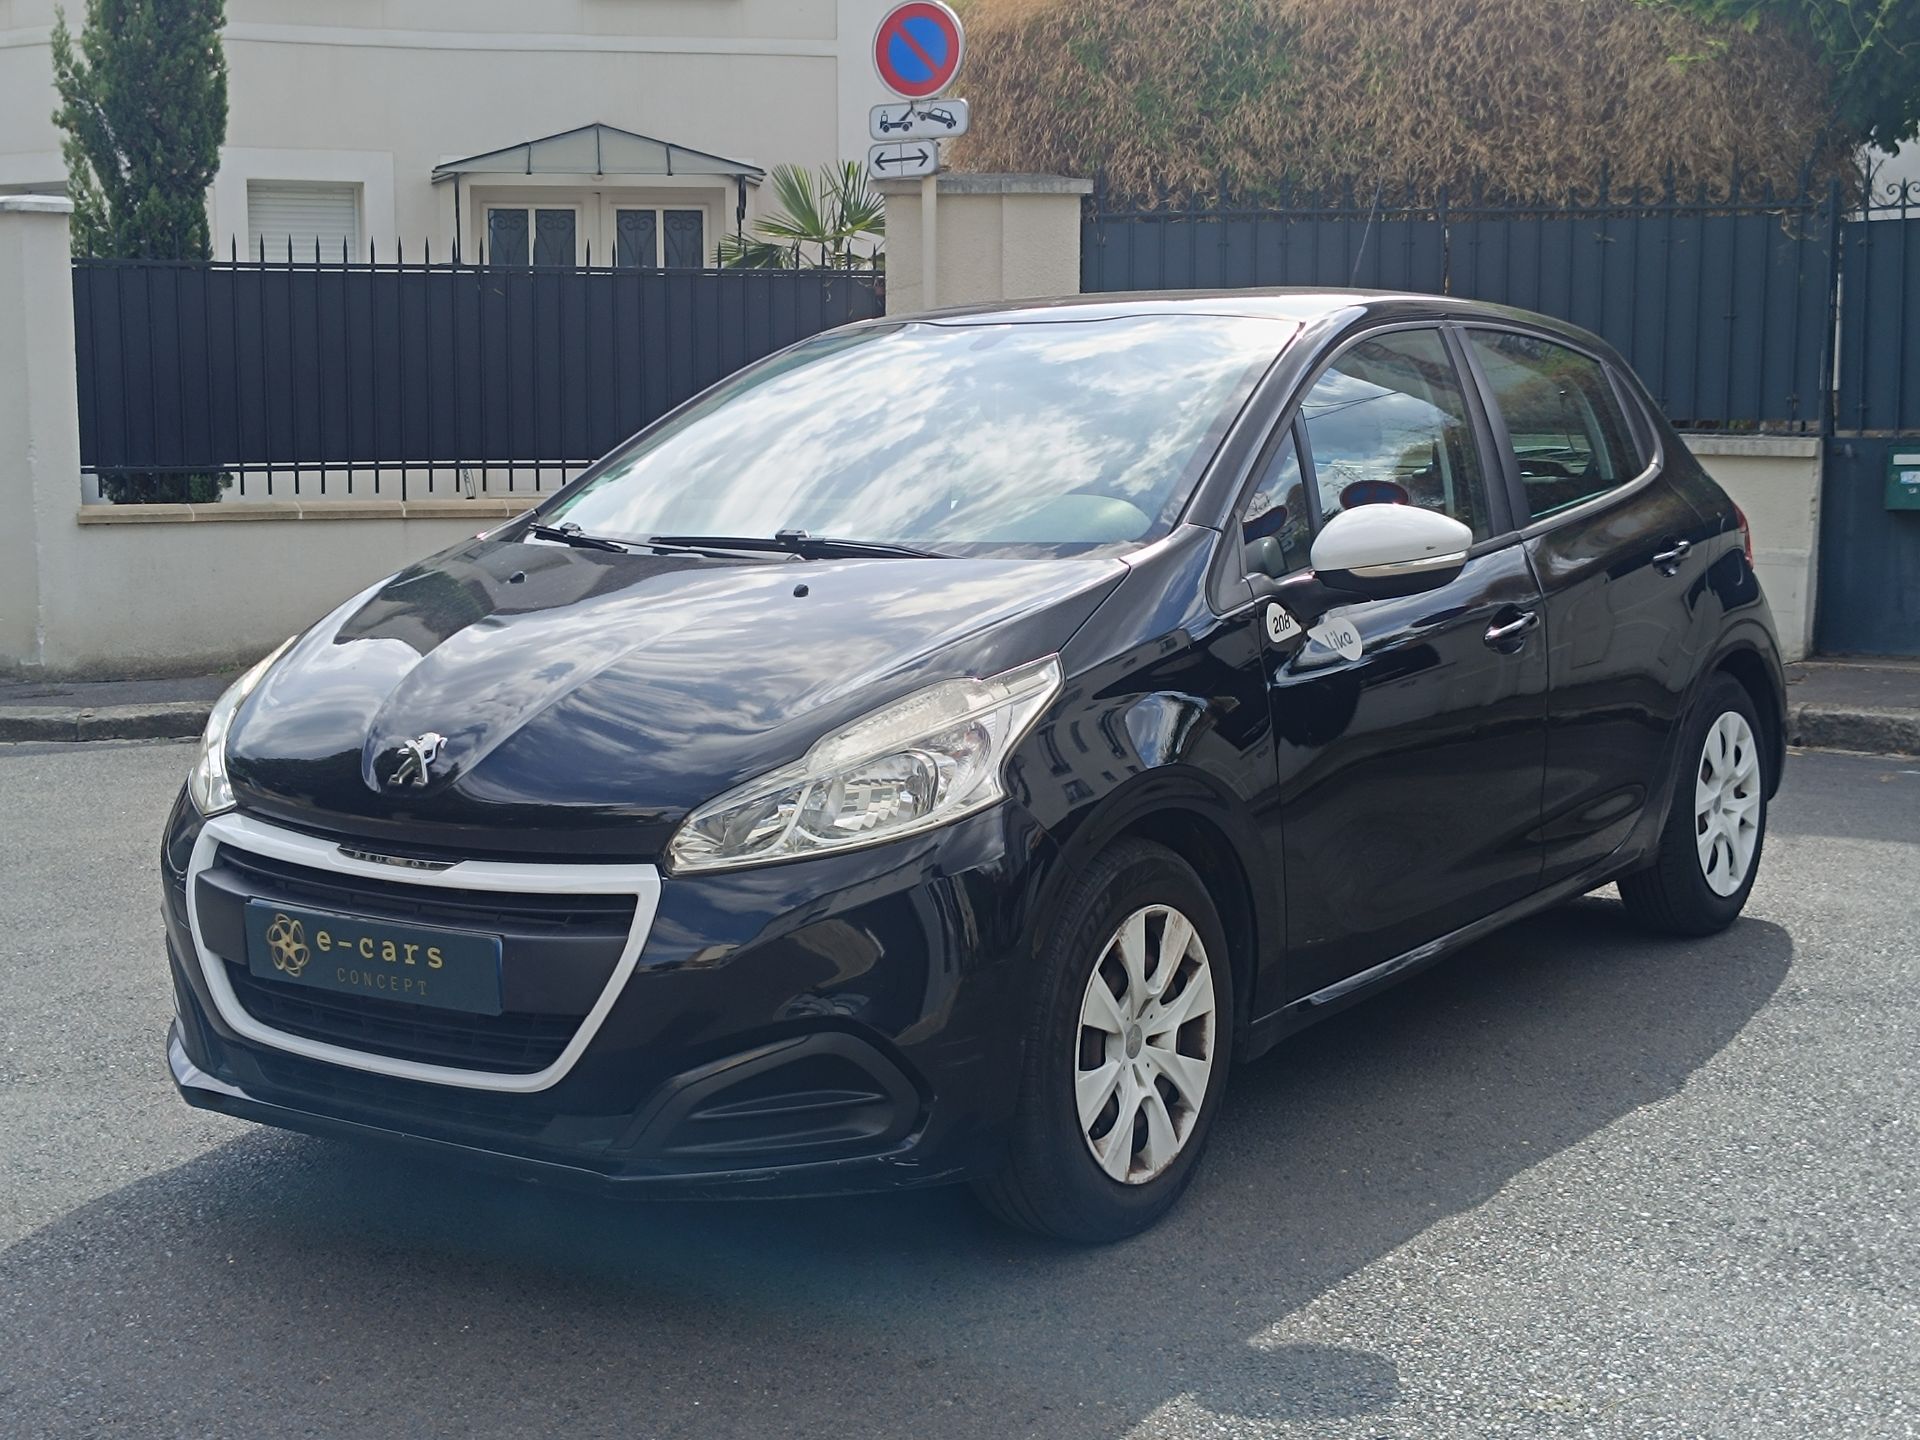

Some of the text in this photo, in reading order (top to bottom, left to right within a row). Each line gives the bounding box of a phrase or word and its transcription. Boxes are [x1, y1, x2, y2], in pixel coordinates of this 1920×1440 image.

[1273, 614, 1291, 634] 208
[353, 850, 431, 869] PEUGOT
[316, 931, 443, 968] e-cars
[337, 968, 427, 995] CONCEPT
